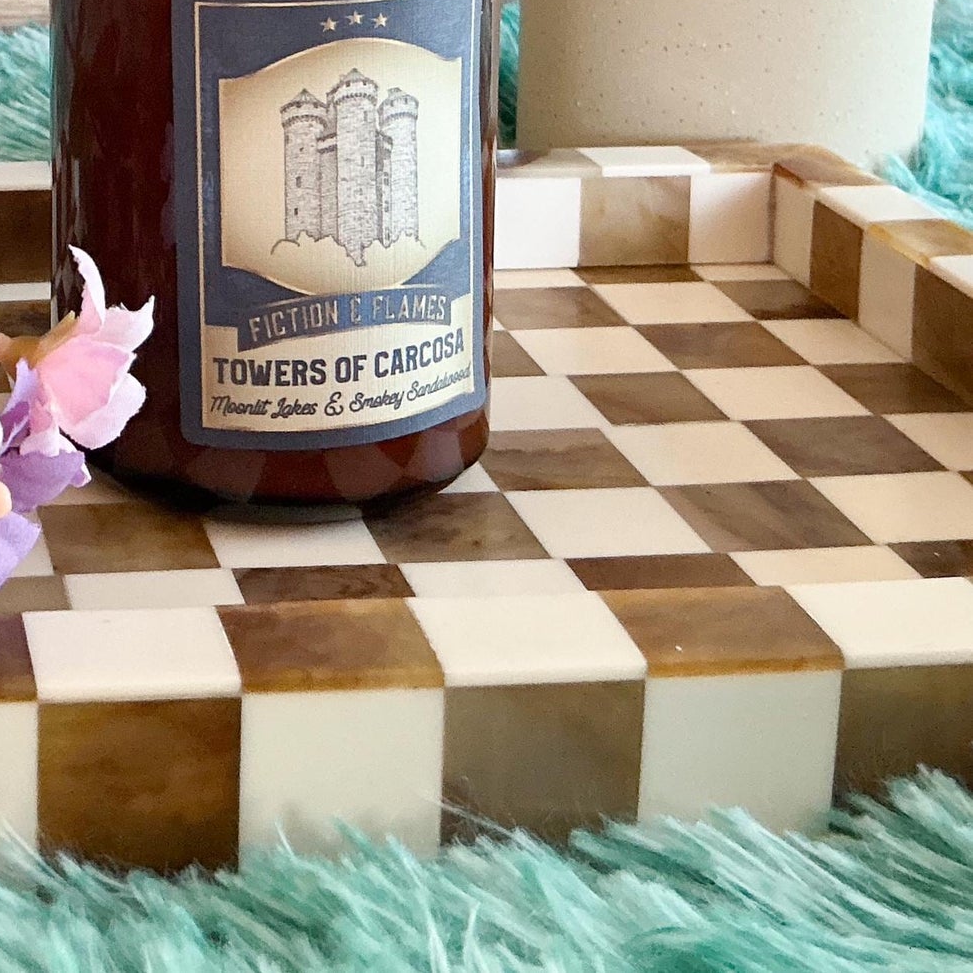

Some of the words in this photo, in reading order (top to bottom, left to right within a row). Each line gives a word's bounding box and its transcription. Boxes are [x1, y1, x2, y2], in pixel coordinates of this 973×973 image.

[248, 298, 338, 342] FICTION
[372, 293, 447, 321] FLAMES
[213, 357, 327, 387] TOWERS
[335, 354, 367, 384] OF
[374, 328, 465, 379] CARCOSA
[211, 395, 273, 416] Moonlit
[270, 397, 319, 419] Lakes
[324, 391, 345, 417] &
[349, 390, 405, 411] Smokey
[407, 361, 471, 402] Sandalwood
